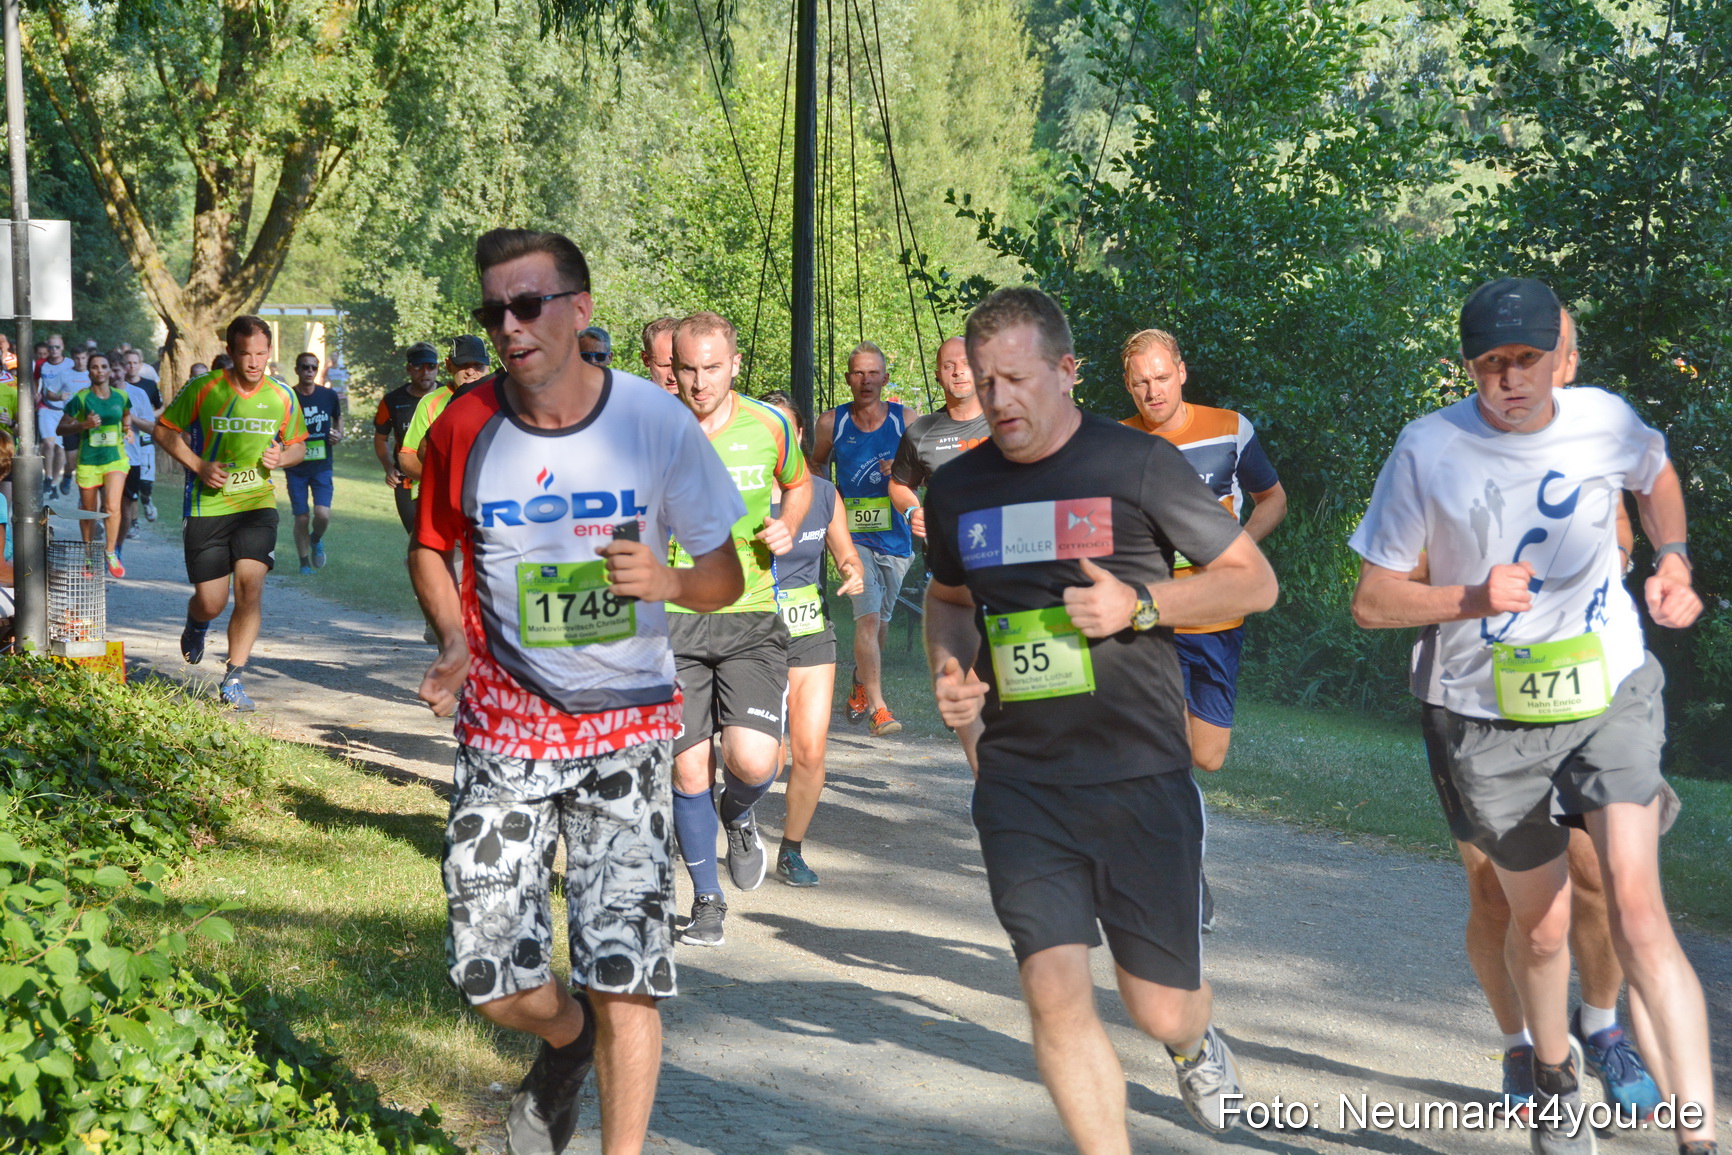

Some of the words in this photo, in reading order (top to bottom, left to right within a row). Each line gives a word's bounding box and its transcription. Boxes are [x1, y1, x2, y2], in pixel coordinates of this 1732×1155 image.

[211, 416, 276, 435] BOCK
[101, 432, 107, 441] 9
[851, 469, 862, 483] Team
[860, 456, 878, 470] Schick
[878, 450, 891, 459] Bau
[231, 469, 256, 485] 220
[854, 510, 881, 522] 507
[1005, 539, 1053, 555] MÜLLER
[962, 550, 999, 561] PEUGEOT
[536, 588, 621, 623] 1748
[527, 622, 595, 633] Markovinovitsch
[596, 617, 631, 629] Christian
[1013, 642, 1050, 675] 55
[1044, 671, 1073, 681] Lothar
[1519, 667, 1580, 699] 471
[1553, 698, 1582, 706] Enrico
[746, 707, 780, 722] saller
